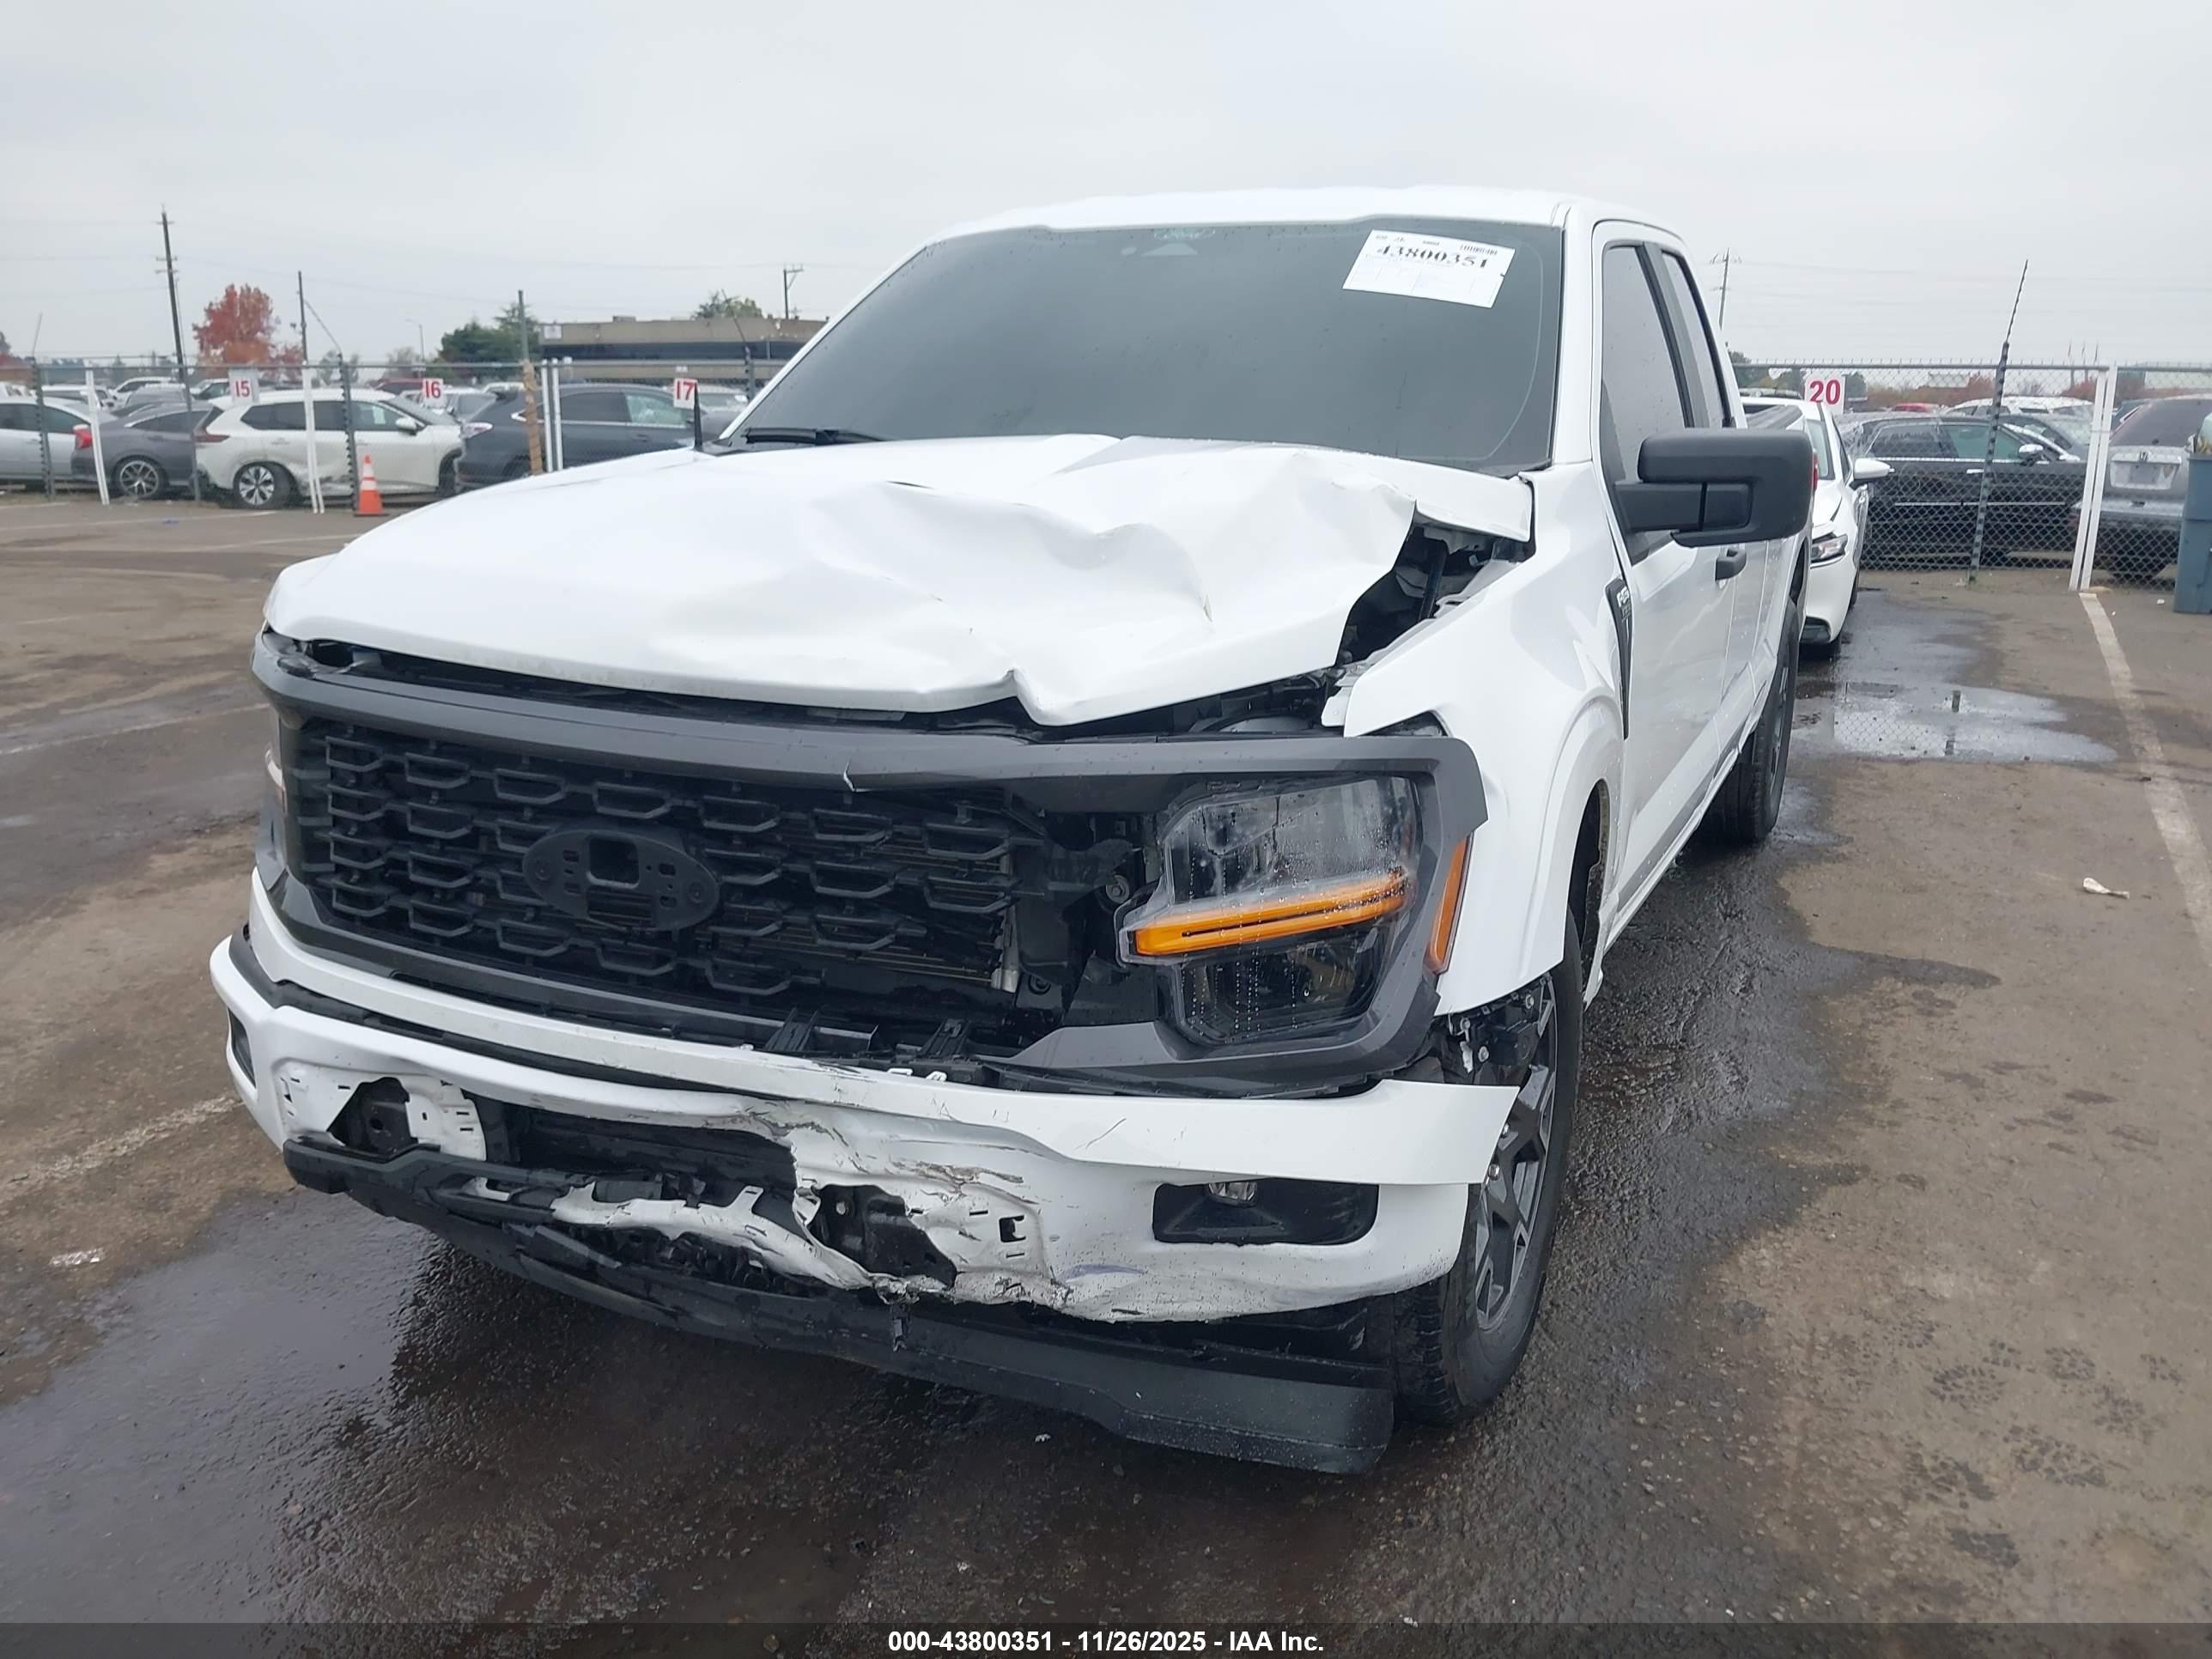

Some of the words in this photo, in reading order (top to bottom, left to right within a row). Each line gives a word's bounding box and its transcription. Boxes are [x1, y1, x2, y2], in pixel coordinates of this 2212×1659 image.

[1376, 245, 1488, 268] 43800351
[235, 380, 251, 398] 15
[425, 380, 441, 399] 16
[677, 380, 695, 400] 17
[1809, 380, 1840, 404] 20
